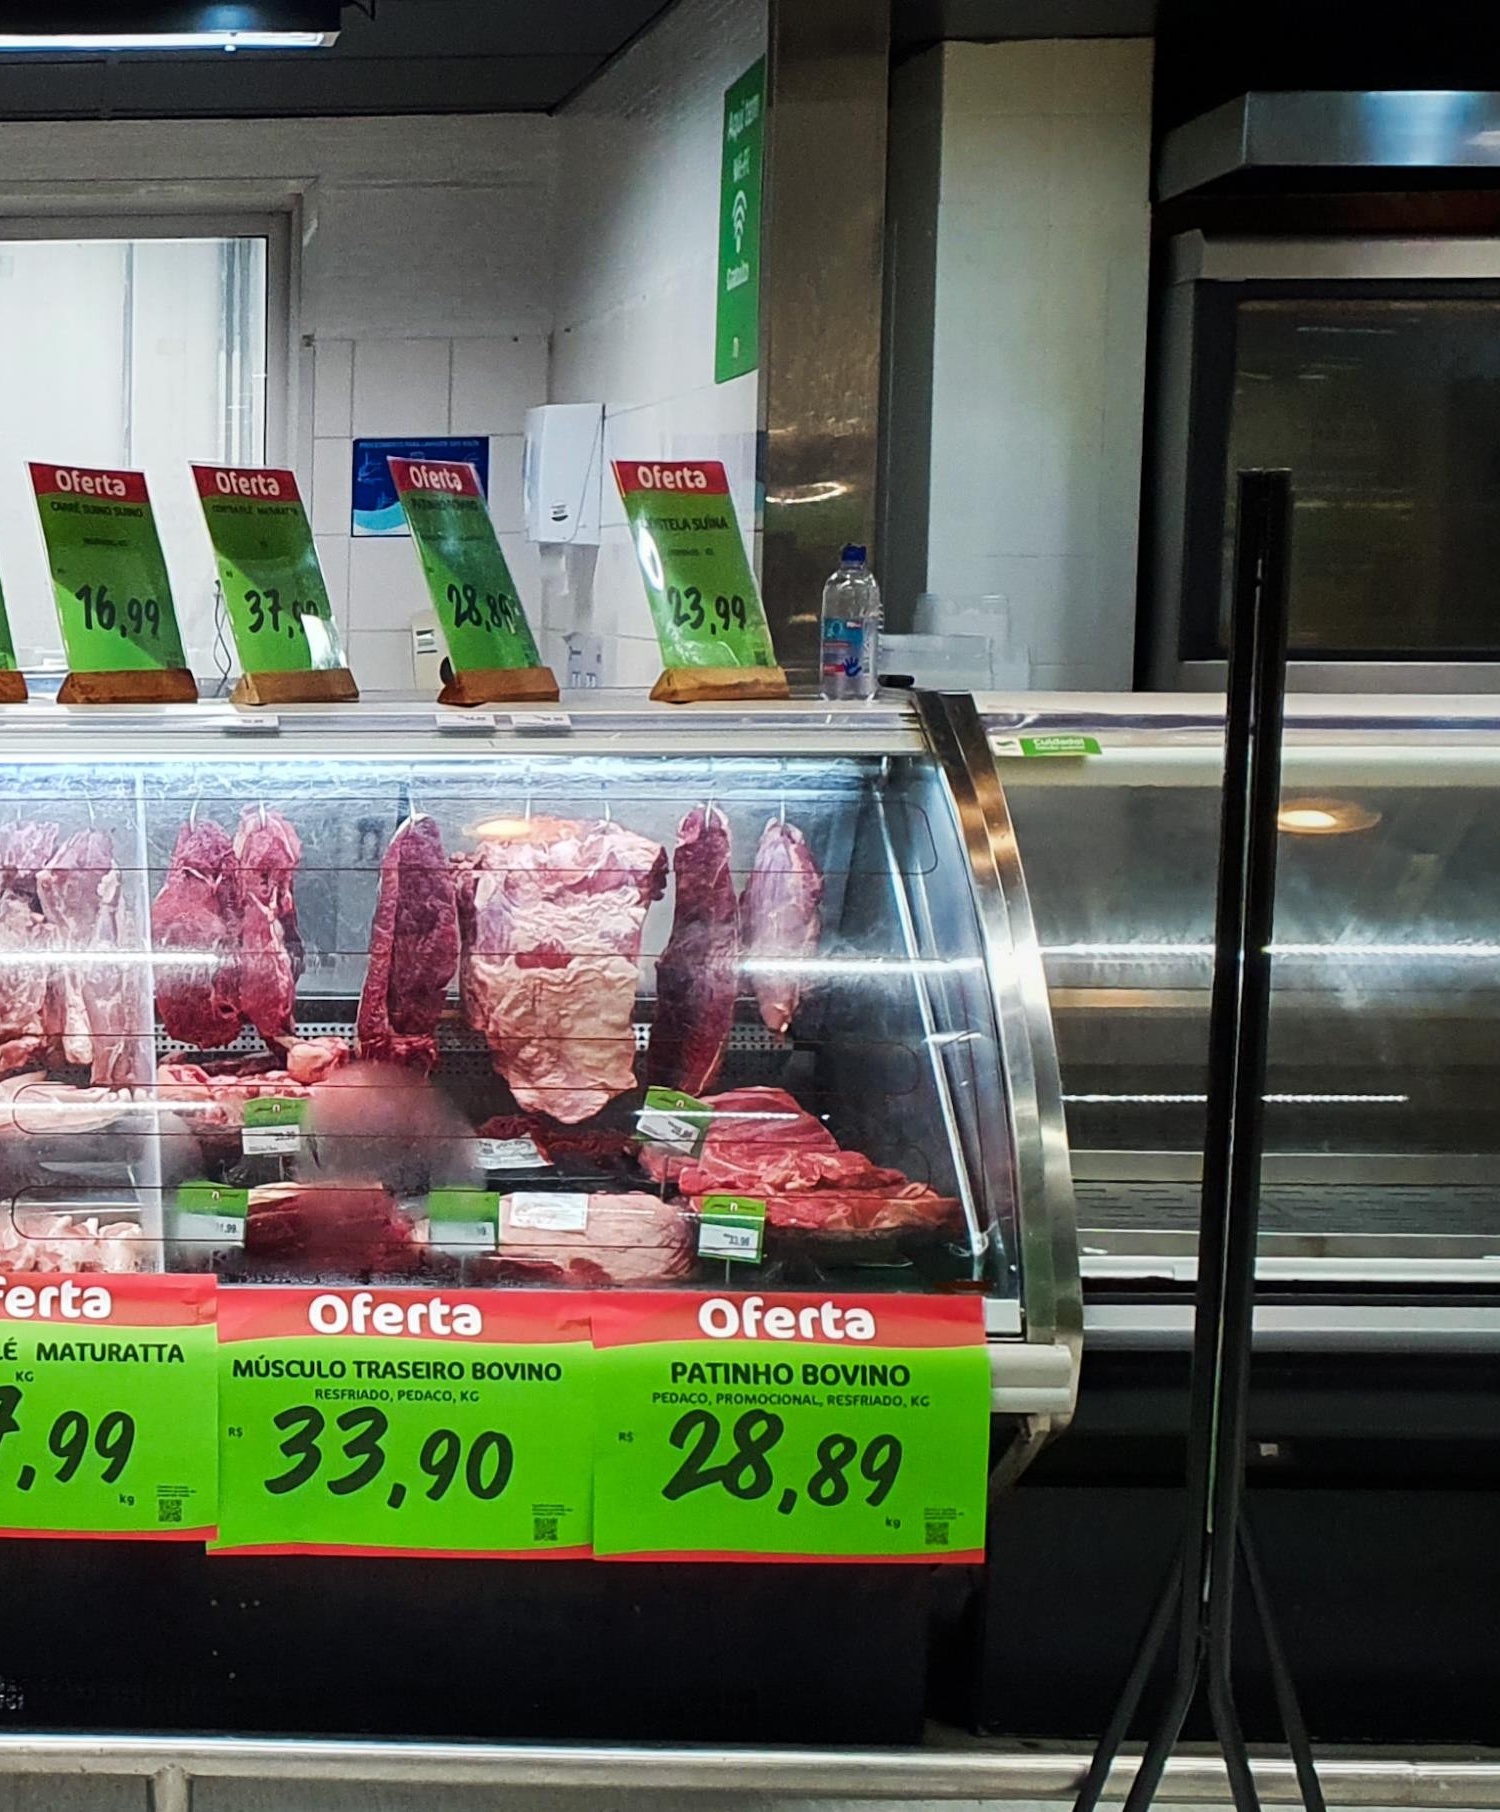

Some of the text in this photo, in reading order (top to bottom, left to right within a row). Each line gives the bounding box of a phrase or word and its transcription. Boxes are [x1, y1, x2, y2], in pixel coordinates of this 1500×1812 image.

[54, 469, 127, 497] Oferta
[214, 471, 281, 496] Oferta
[409, 465, 463, 492] Oferta
[636, 465, 708, 489] Oferta
[75, 584, 161, 639] 16,99
[667, 585, 747, 635] 23,99
[308, 1293, 483, 1336] Oferta
[698, 1296, 877, 1340] Oferta
[36, 1342, 185, 1363] MATURATTA
[15, 1371, 34, 1383] KG
[232, 1355, 562, 1381] MÚSCULO TRASEIRO BOVINO
[671, 1361, 911, 1387] PATINHO BOVINO
[315, 1389, 394, 1403] RESFRIADO,
[460, 1391, 480, 1402] KG
[716, 1393, 824, 1408] PROMOCIONAL,
[827, 1395, 908, 1408] RESFRIADO,
[911, 1396, 930, 1407] KG
[228, 1427, 243, 1438] R$
[264, 1405, 514, 1509] 33,90
[661, 1408, 903, 1516] 28,89
[119, 1493, 135, 1506] kg
[885, 1517, 901, 1529] kg
